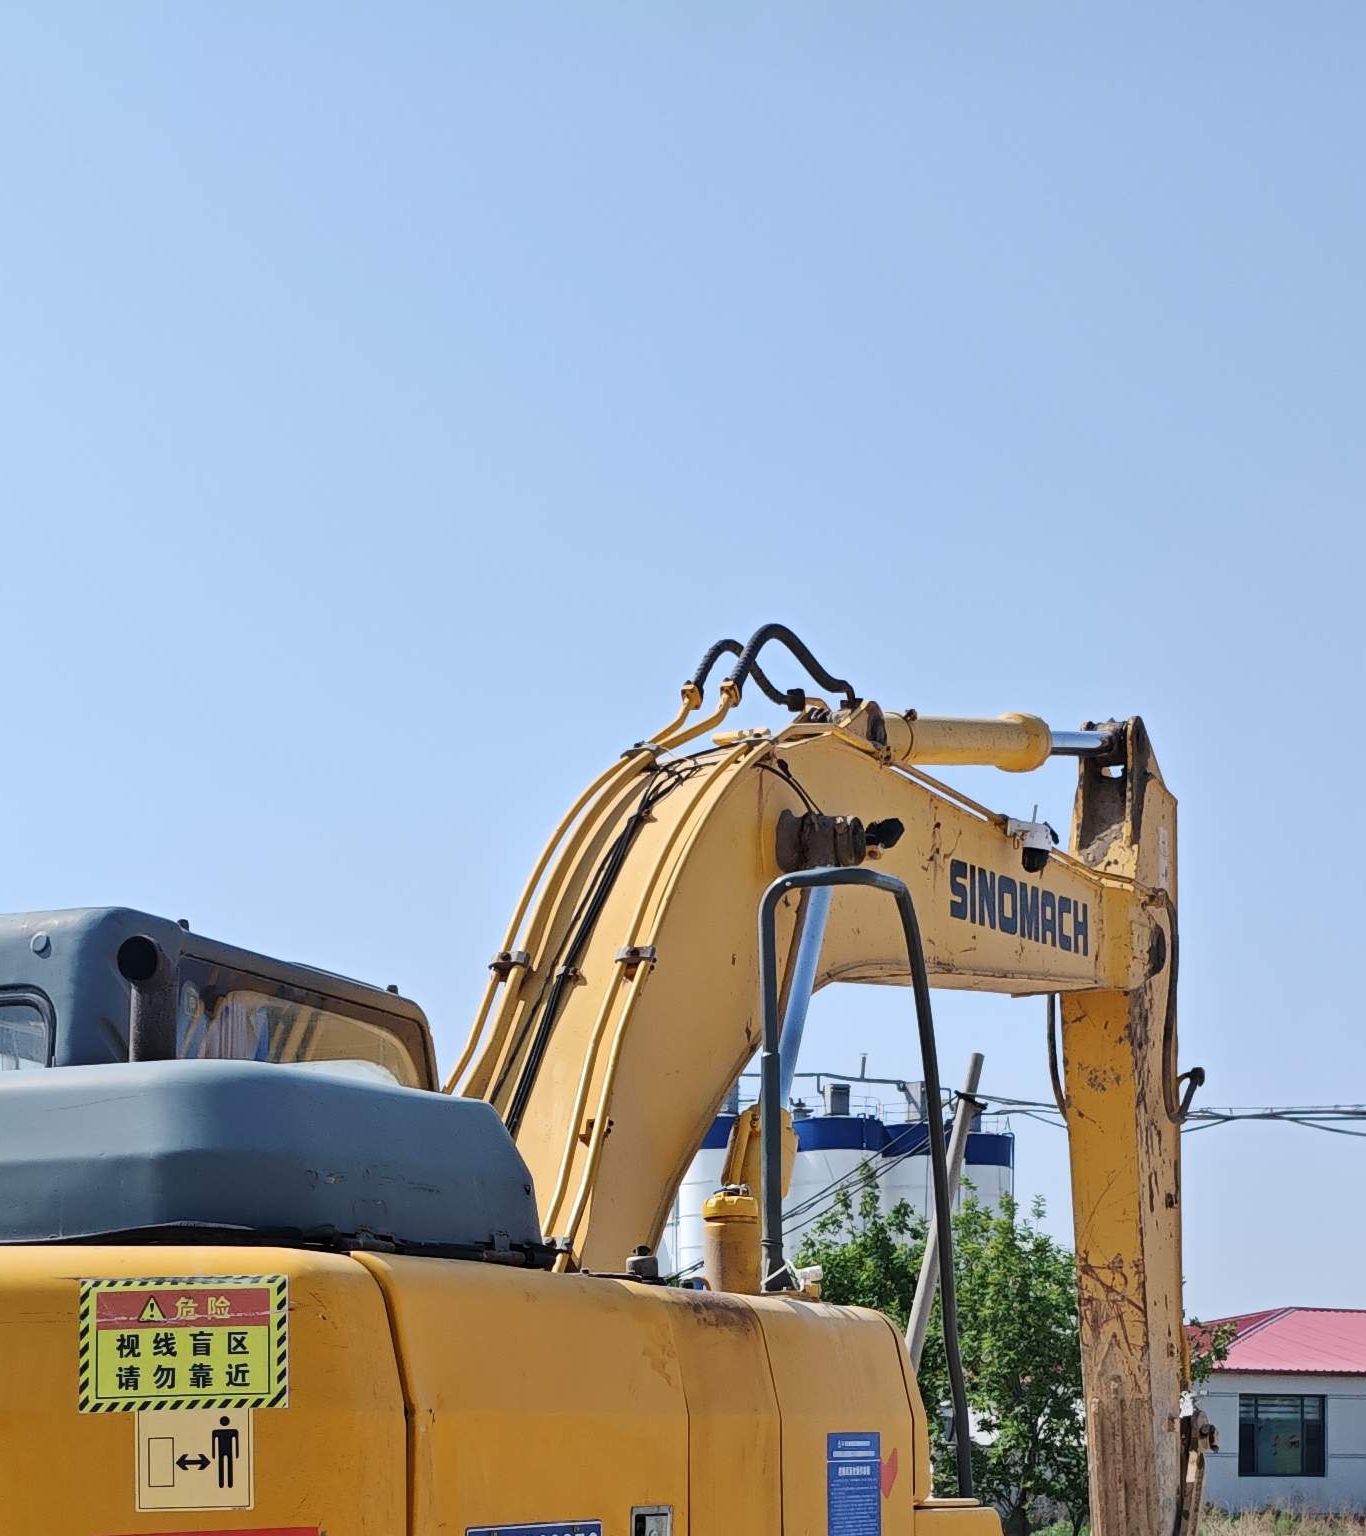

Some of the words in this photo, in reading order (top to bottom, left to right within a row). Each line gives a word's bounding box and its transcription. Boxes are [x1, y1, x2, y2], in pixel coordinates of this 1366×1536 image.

[950, 858, 1089, 957] SINOMACH
[175, 1295, 232, 1321] 危险
[115, 1331, 250, 1359] 视线盲区
[115, 1363, 250, 1391] 请勿靠近
